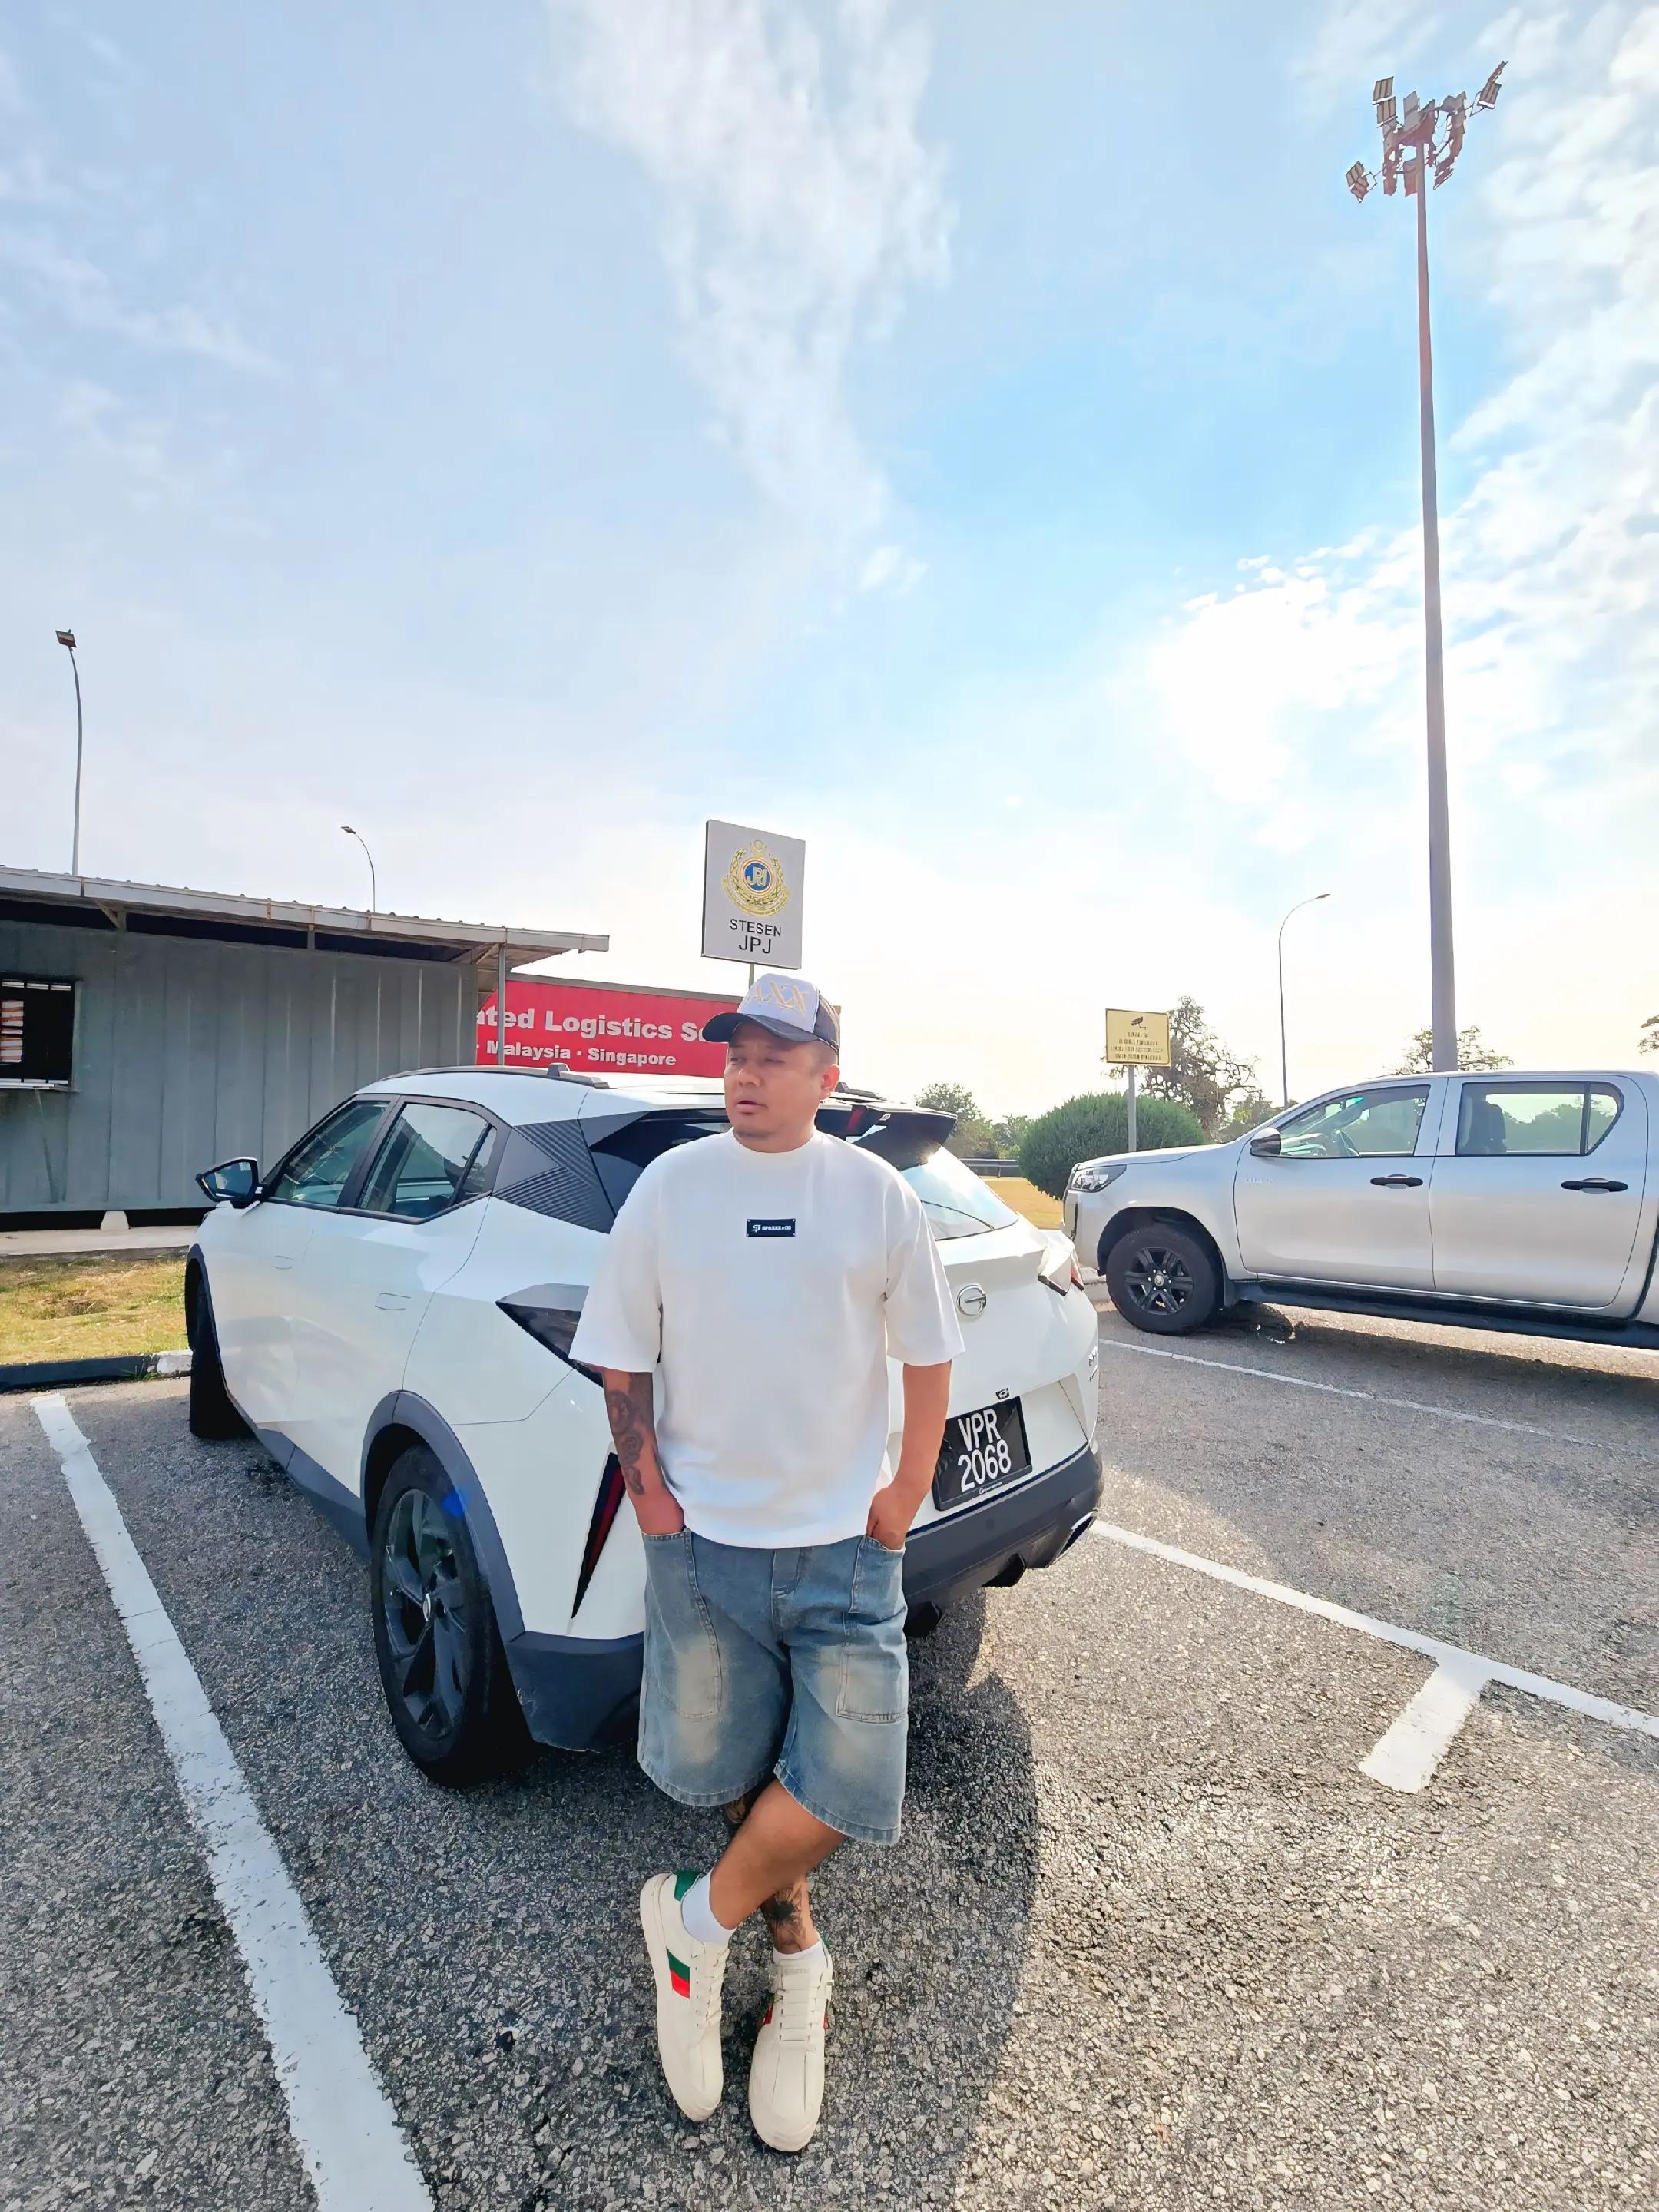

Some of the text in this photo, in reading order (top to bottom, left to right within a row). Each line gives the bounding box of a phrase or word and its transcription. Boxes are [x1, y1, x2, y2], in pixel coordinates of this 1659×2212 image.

[730, 919, 781, 937] STESEN
[739, 935, 771, 954] JPJ
[545, 1010, 673, 1039] Logistics
[680, 1022, 707, 1042] S
[486, 1040, 677, 1067] Malaysia Singapore
[957, 1409, 1001, 1452] VPR
[957, 1439, 1012, 1492] 2068
